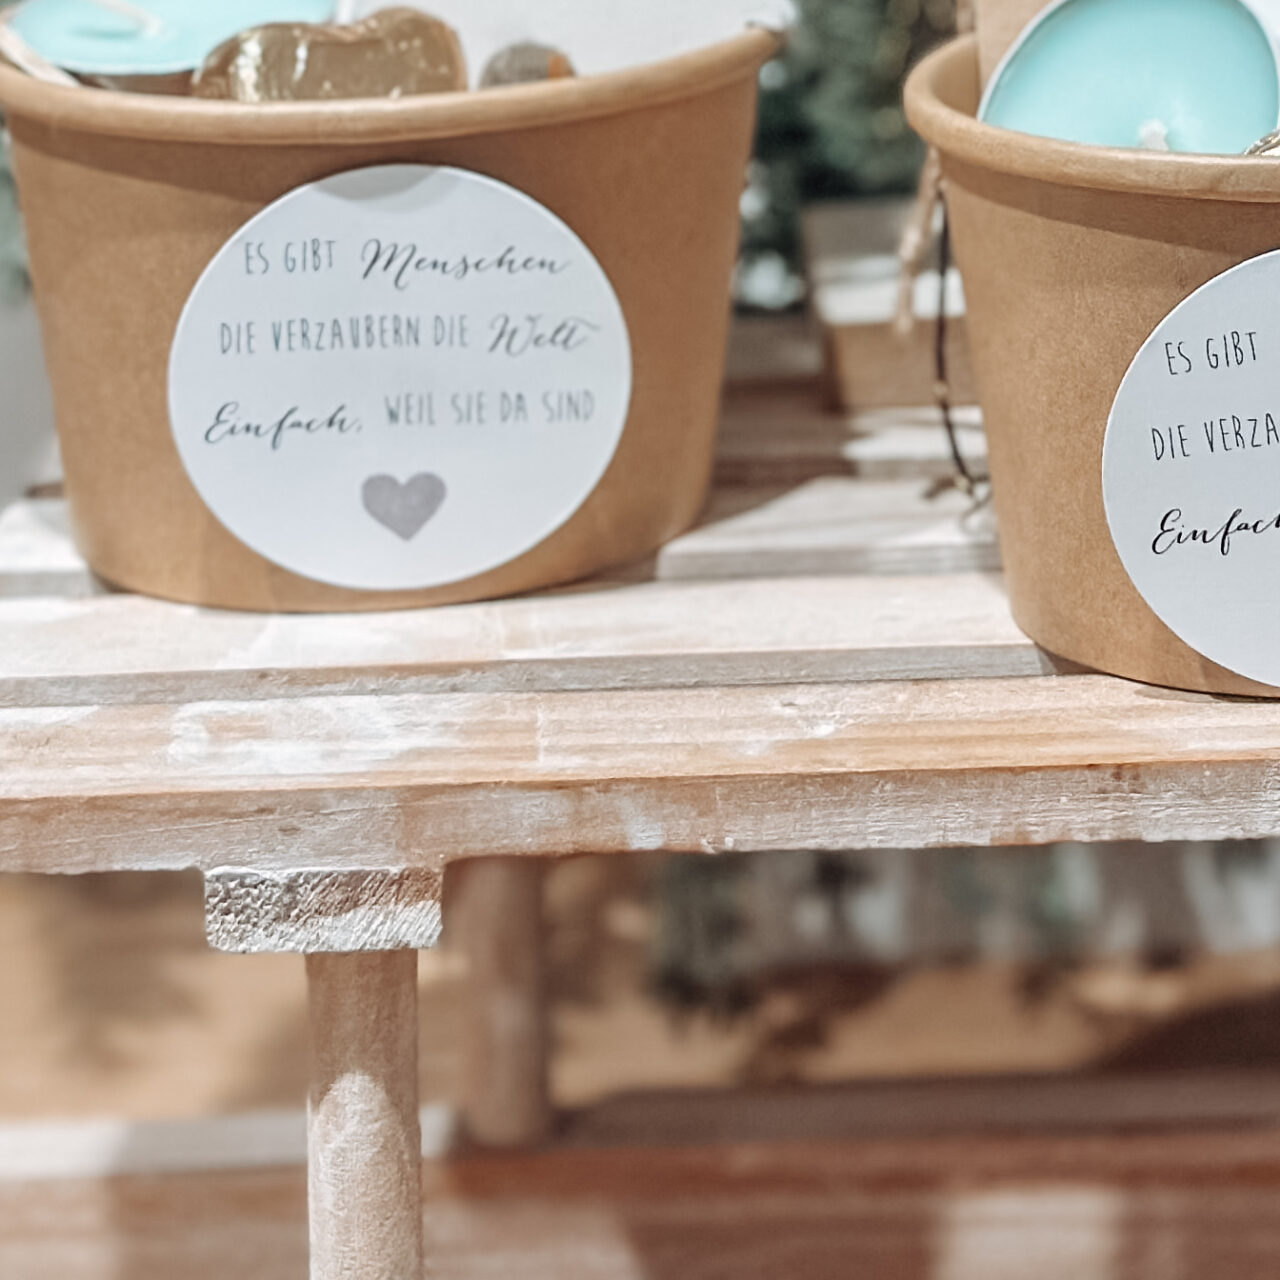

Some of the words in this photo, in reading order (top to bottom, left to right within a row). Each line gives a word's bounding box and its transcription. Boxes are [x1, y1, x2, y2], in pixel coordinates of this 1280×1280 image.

[245, 241, 269, 275] ES
[284, 239, 337, 273] GIBT
[361, 238, 573, 290] Menschen
[220, 322, 257, 355] DIE
[272, 315, 420, 352] VERZAUBERN
[434, 314, 470, 348] DIE
[487, 312, 600, 357] Welt
[1165, 340, 1193, 376] ES
[1206, 331, 1258, 369] GIBT
[204, 401, 363, 451] Einfach,
[384, 393, 437, 427] WEIL
[452, 391, 487, 425] SIE
[501, 391, 529, 423] DA
[1151, 422, 1191, 461] DIE
